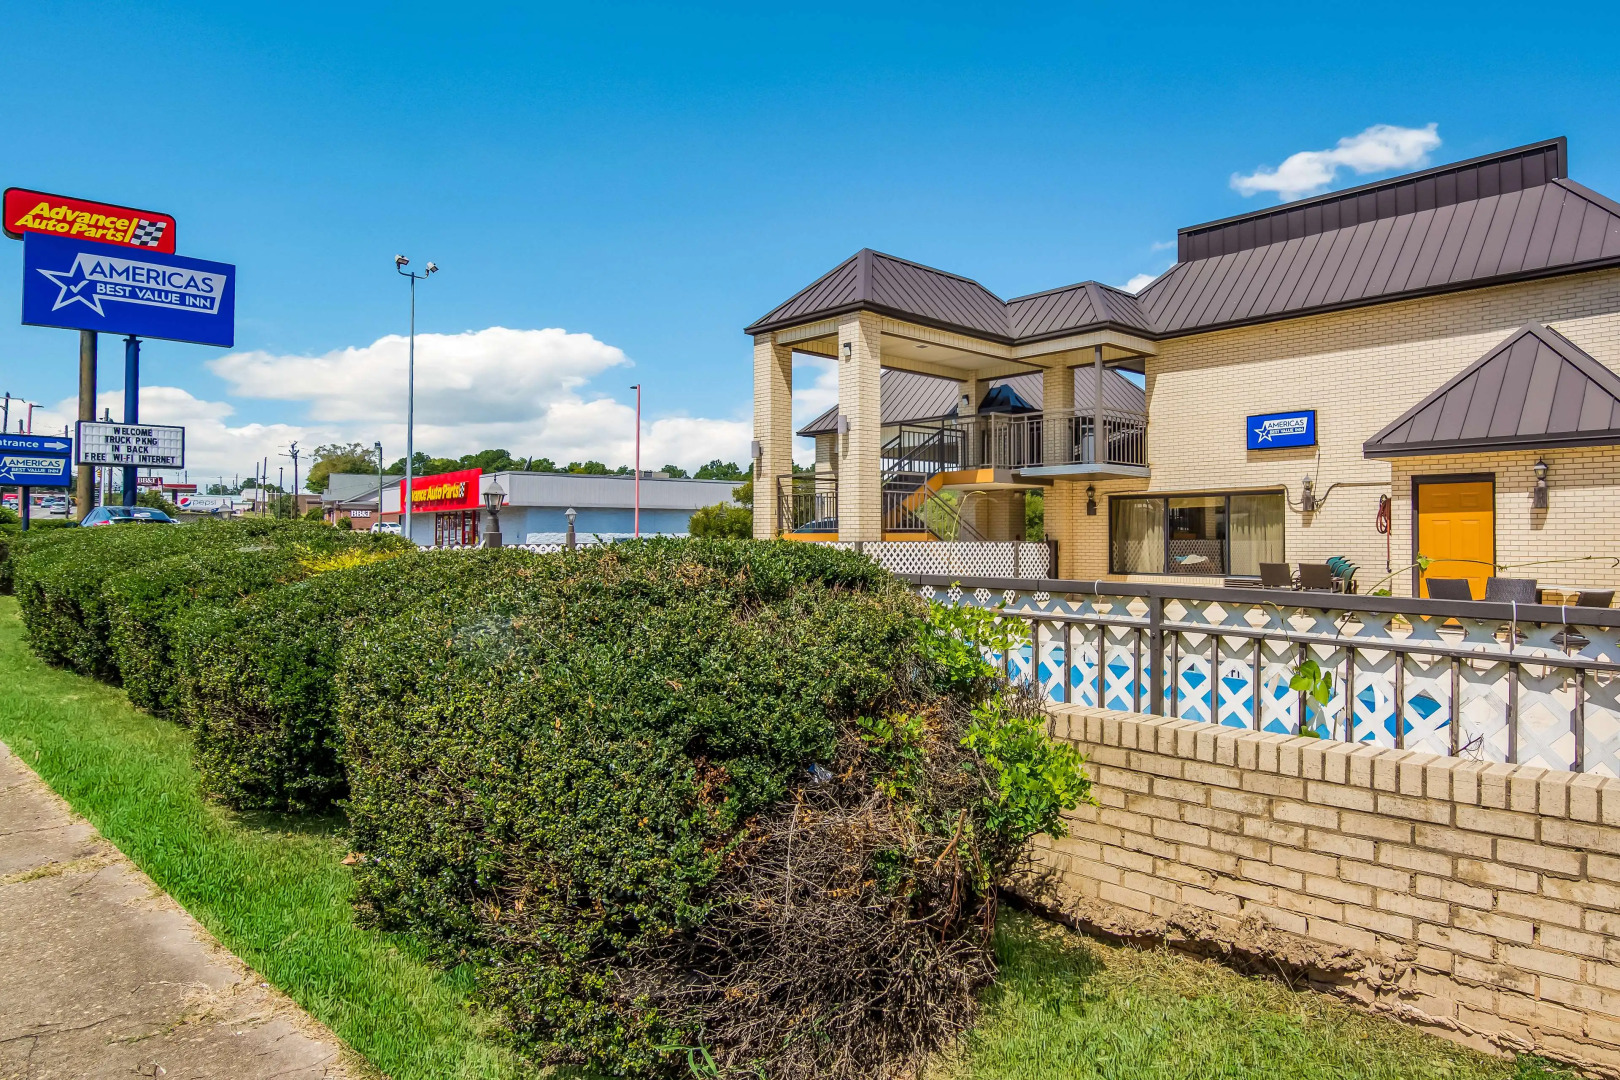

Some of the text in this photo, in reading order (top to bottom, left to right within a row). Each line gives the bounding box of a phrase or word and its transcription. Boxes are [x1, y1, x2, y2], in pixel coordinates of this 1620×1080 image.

[28, 202, 130, 230] Advance
[14, 214, 125, 243] Auto Parts
[89, 260, 214, 294] AMERICAS
[96, 282, 211, 309] BEST VALUE INN
[1268, 419, 1304, 428] AMERICAS
[113, 427, 153, 437] WELCOME
[0, 439, 39, 448] trance
[105, 435, 158, 446] TRUCK PKNG
[8, 459, 60, 468] AMERICAS
[84, 453, 176, 464] FREE WI-FI INTERNET
[405, 483, 459, 502] vance Auto Parts
